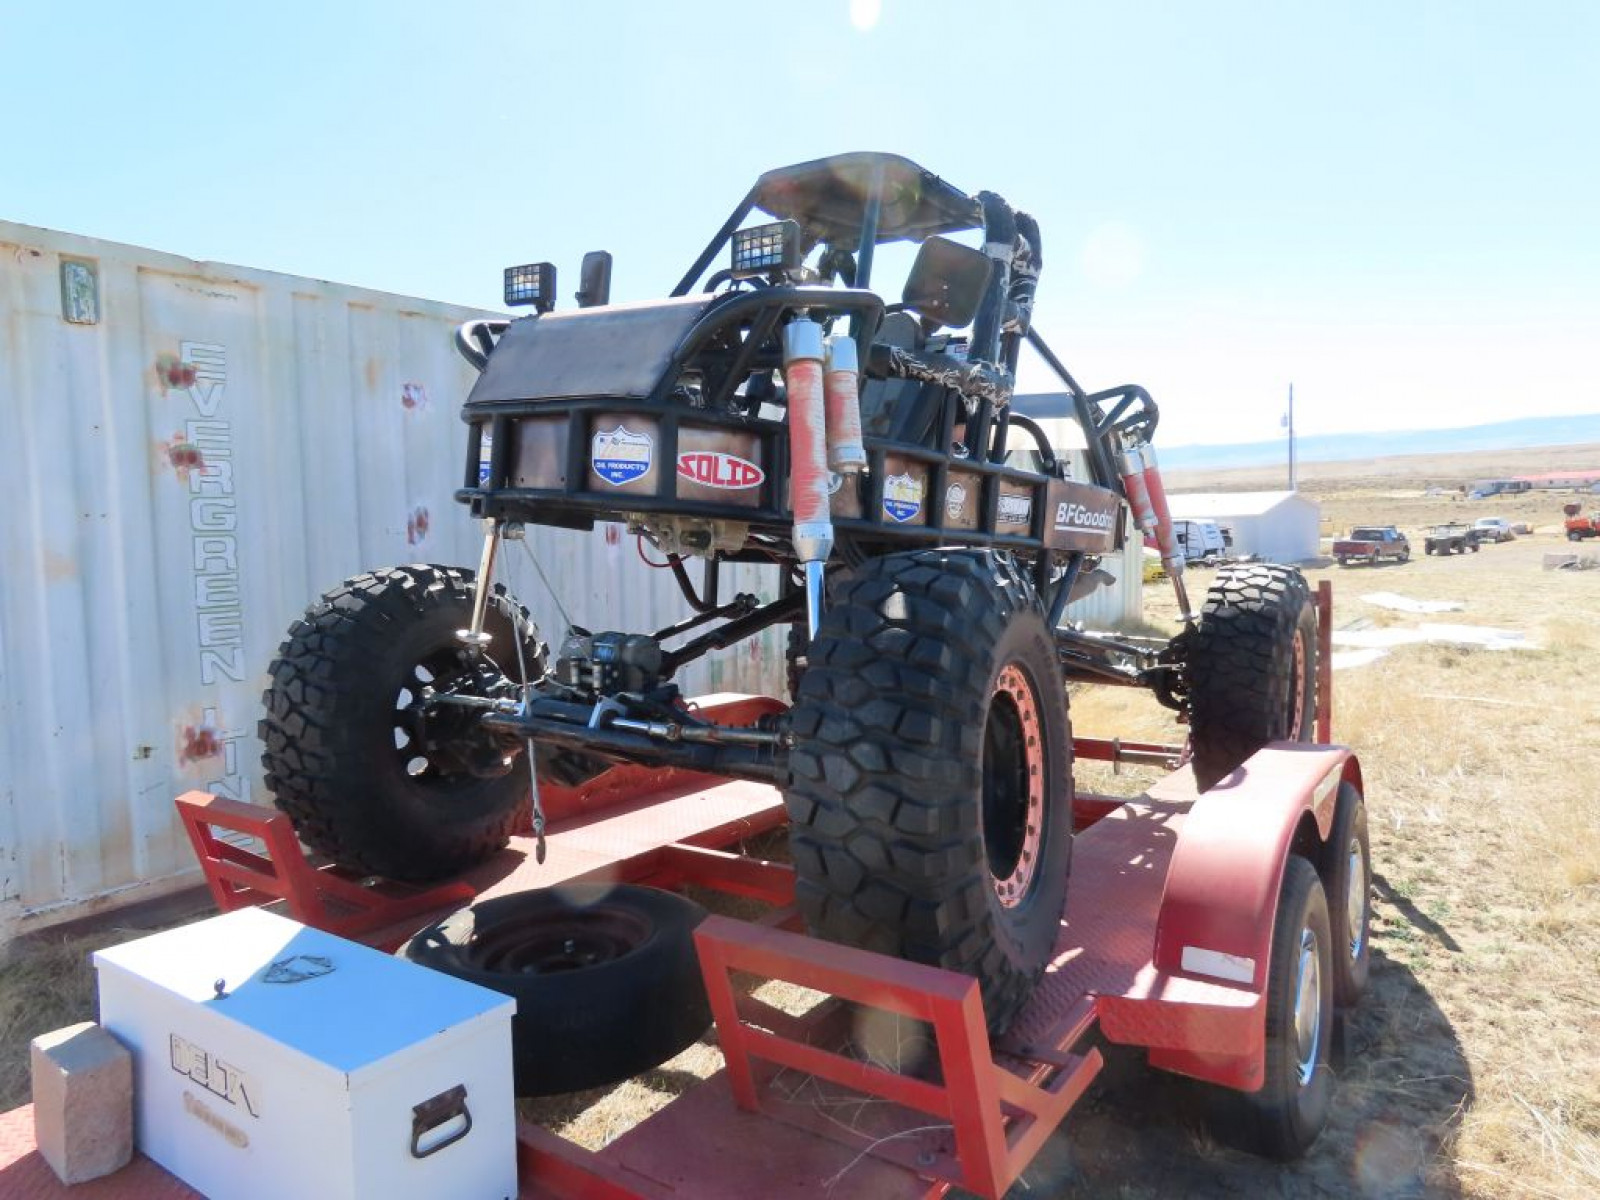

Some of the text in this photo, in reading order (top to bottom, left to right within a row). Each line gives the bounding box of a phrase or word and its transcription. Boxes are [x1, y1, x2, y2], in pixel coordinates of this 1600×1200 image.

[180, 340, 246, 685] EVERGREEN
[677, 454, 761, 487] SOLID
[170, 1032, 260, 1118] DELTA
